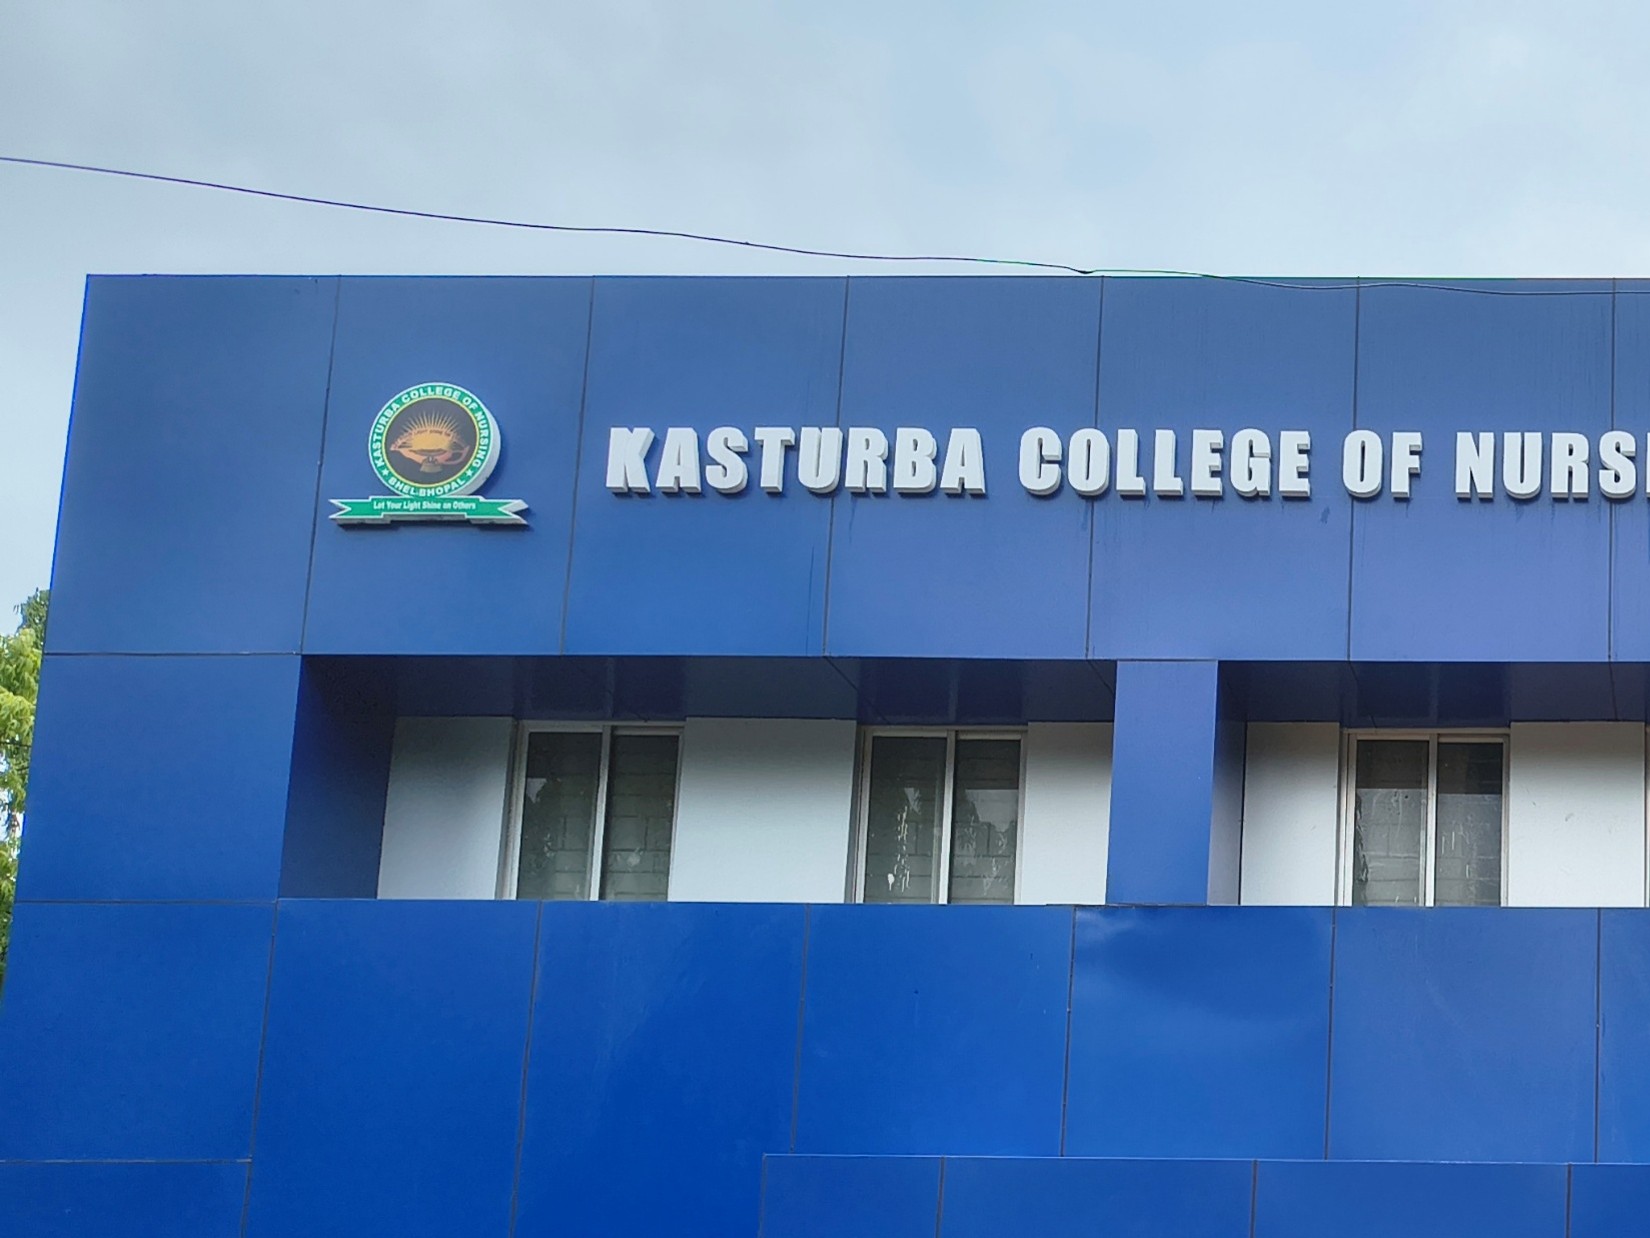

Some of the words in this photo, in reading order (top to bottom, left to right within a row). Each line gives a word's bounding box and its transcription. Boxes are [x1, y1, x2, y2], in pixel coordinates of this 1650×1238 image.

[371, 402, 401, 467] KASTURBA
[402, 385, 461, 402] COLLEGE
[462, 397, 478, 410] OF
[474, 410, 490, 468] NURSING
[606, 427, 987, 495] KASTURBA
[1018, 427, 1311, 497] COLLEGE
[1342, 430, 1423, 498] OF
[373, 501, 384, 510] Let
[386, 501, 402, 510] Your
[403, 501, 420, 511] Light
[422, 501, 441, 510] Shine
[453, 501, 476, 510] Others
